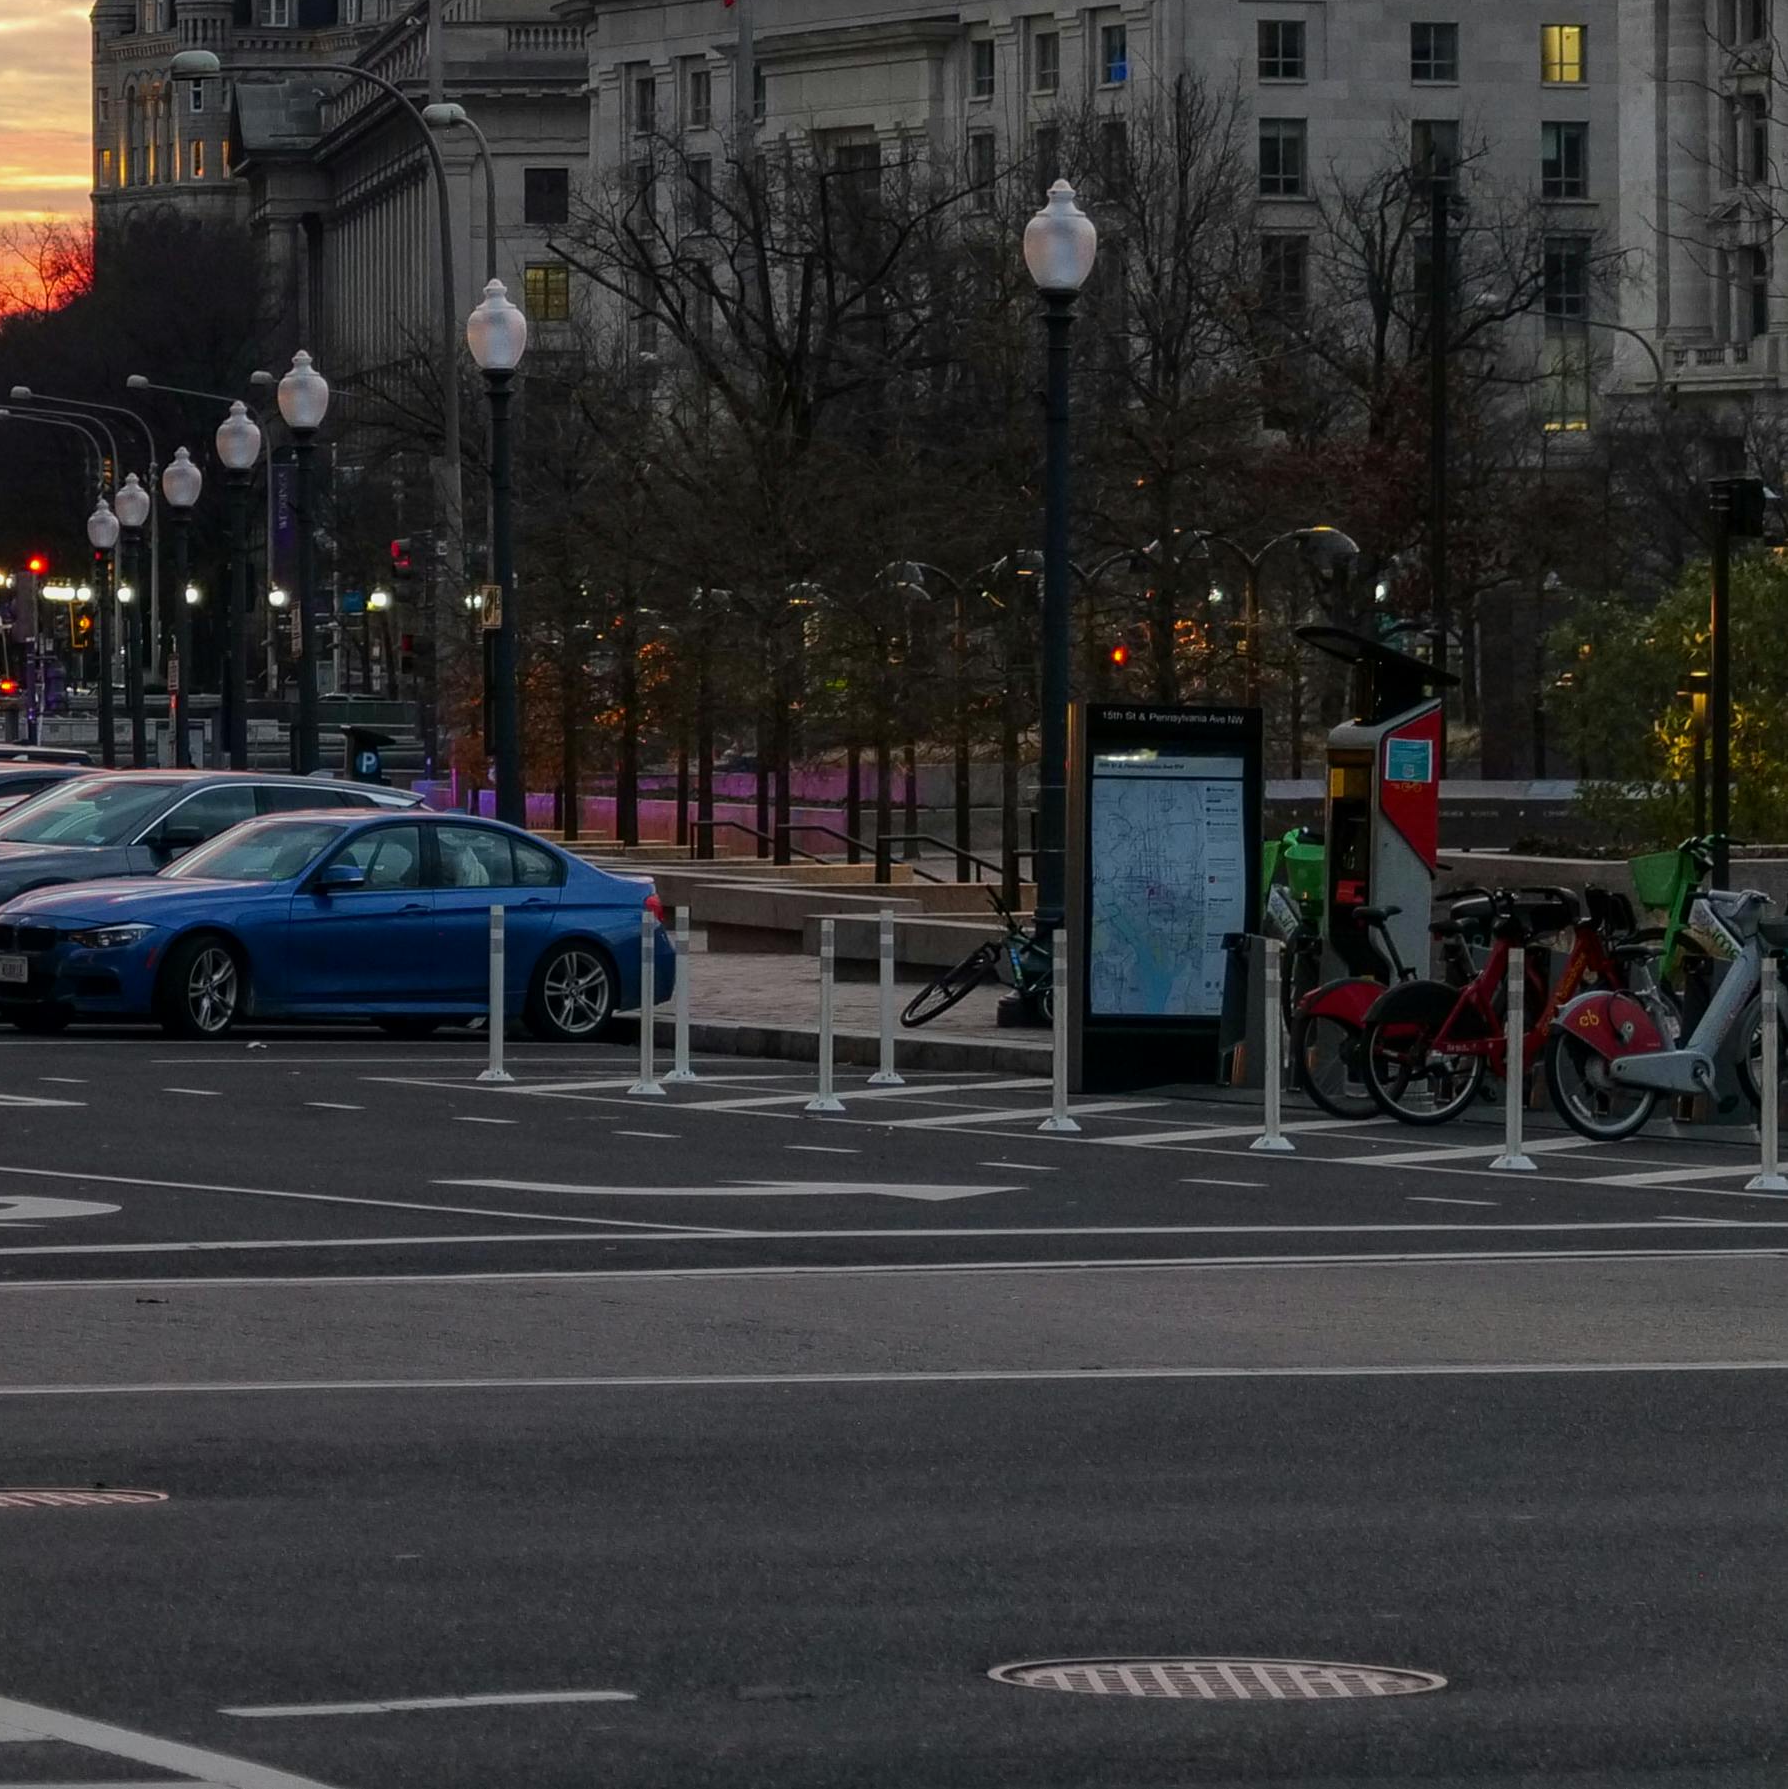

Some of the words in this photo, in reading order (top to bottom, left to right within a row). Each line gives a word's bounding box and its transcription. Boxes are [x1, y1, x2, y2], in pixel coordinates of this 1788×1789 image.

[1103, 710, 1124, 721] 15th
[1125, 711, 1137, 722] St
[1138, 712, 1147, 722] &
[1148, 712, 1207, 725] Pennsylvania
[1209, 714, 1226, 724] Ave
[1227, 715, 1244, 725] NW
[361, 751, 376, 774] P
